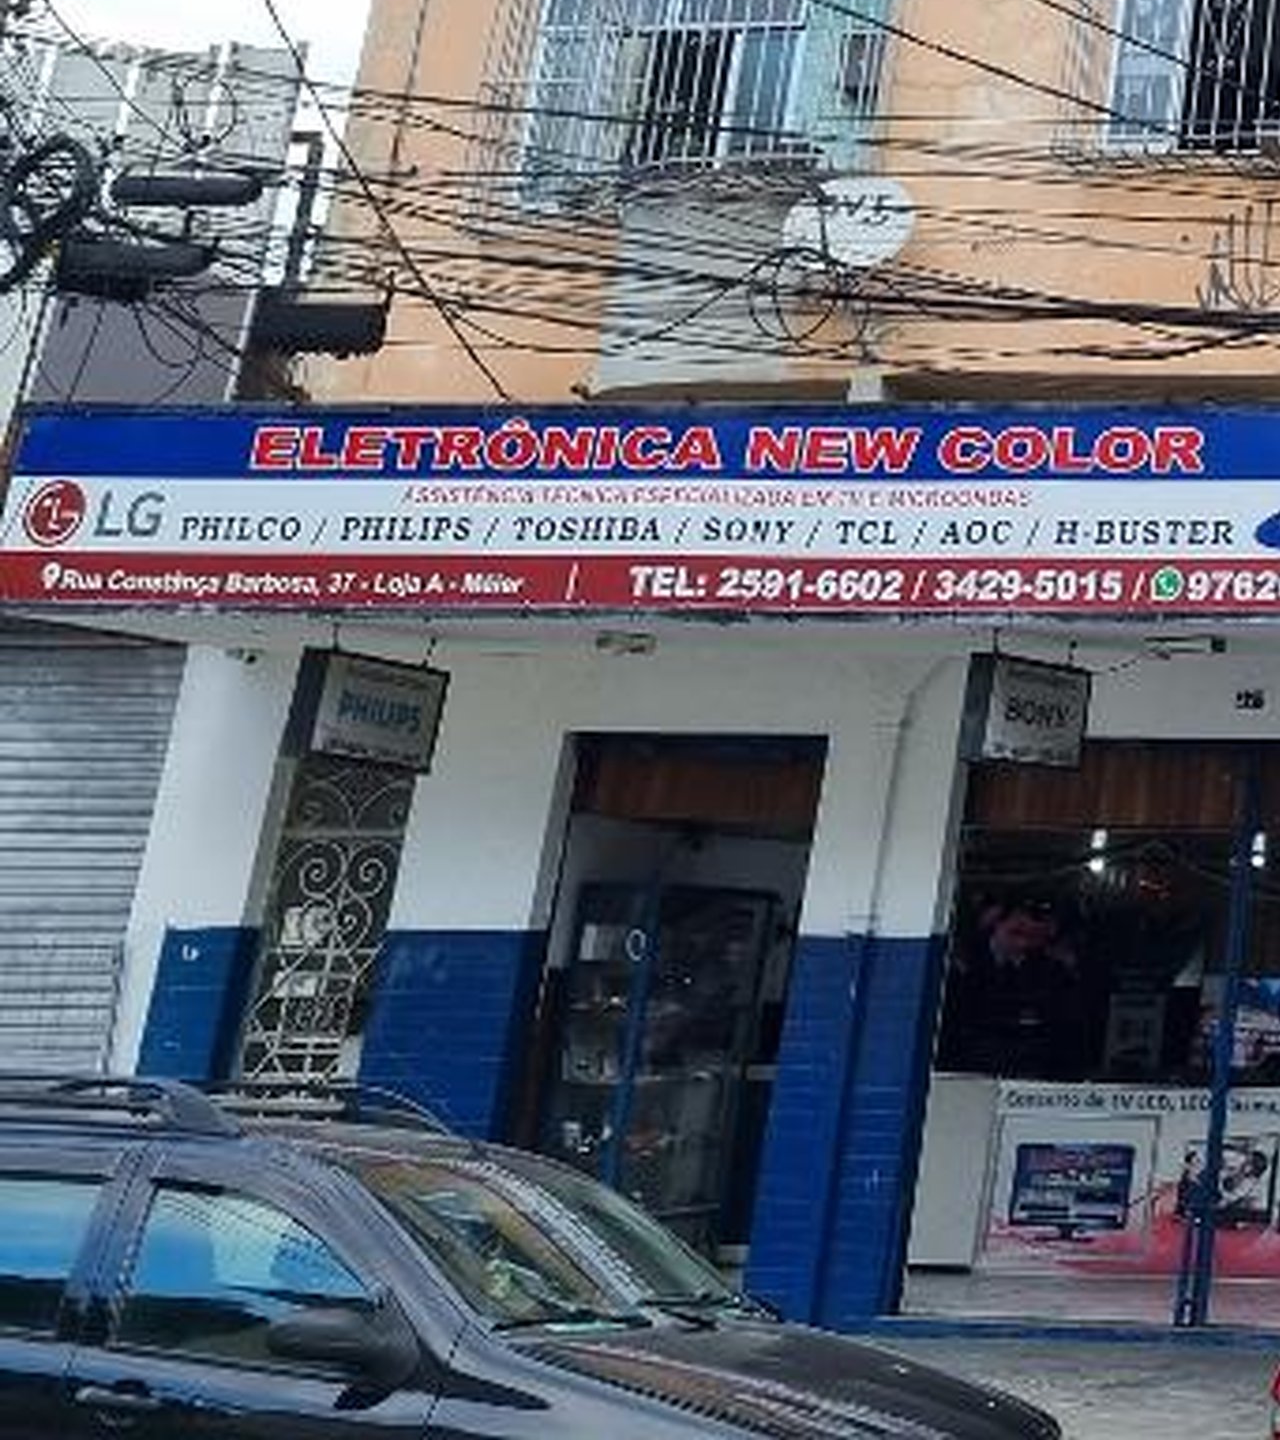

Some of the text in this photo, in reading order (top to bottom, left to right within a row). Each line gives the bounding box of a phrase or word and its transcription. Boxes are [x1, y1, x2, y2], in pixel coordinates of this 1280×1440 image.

[251, 420, 1203, 473] ELETRÔNICA NEW COLOR
[93, 491, 164, 537] LG
[179, 517, 302, 543] PHILCO
[340, 516, 472, 543] PHILIPS
[513, 516, 661, 543] TOSHIBA
[702, 517, 795, 544] SONY
[836, 520, 899, 545] TCL
[940, 520, 1012, 545] AOC
[1053, 519, 1235, 548] H-BUSTER
[59, 569, 102, 590] Rua
[225, 572, 320, 597] Barbosa,
[328, 572, 357, 594] 37
[374, 572, 421, 597] Loja
[424, 572, 444, 594] A
[629, 566, 708, 597] TEL:
[715, 569, 903, 600] 2591-6602
[910, 569, 928, 601] /
[934, 569, 1123, 601] 3429-5015
[337, 689, 421, 734] PHILIPS
